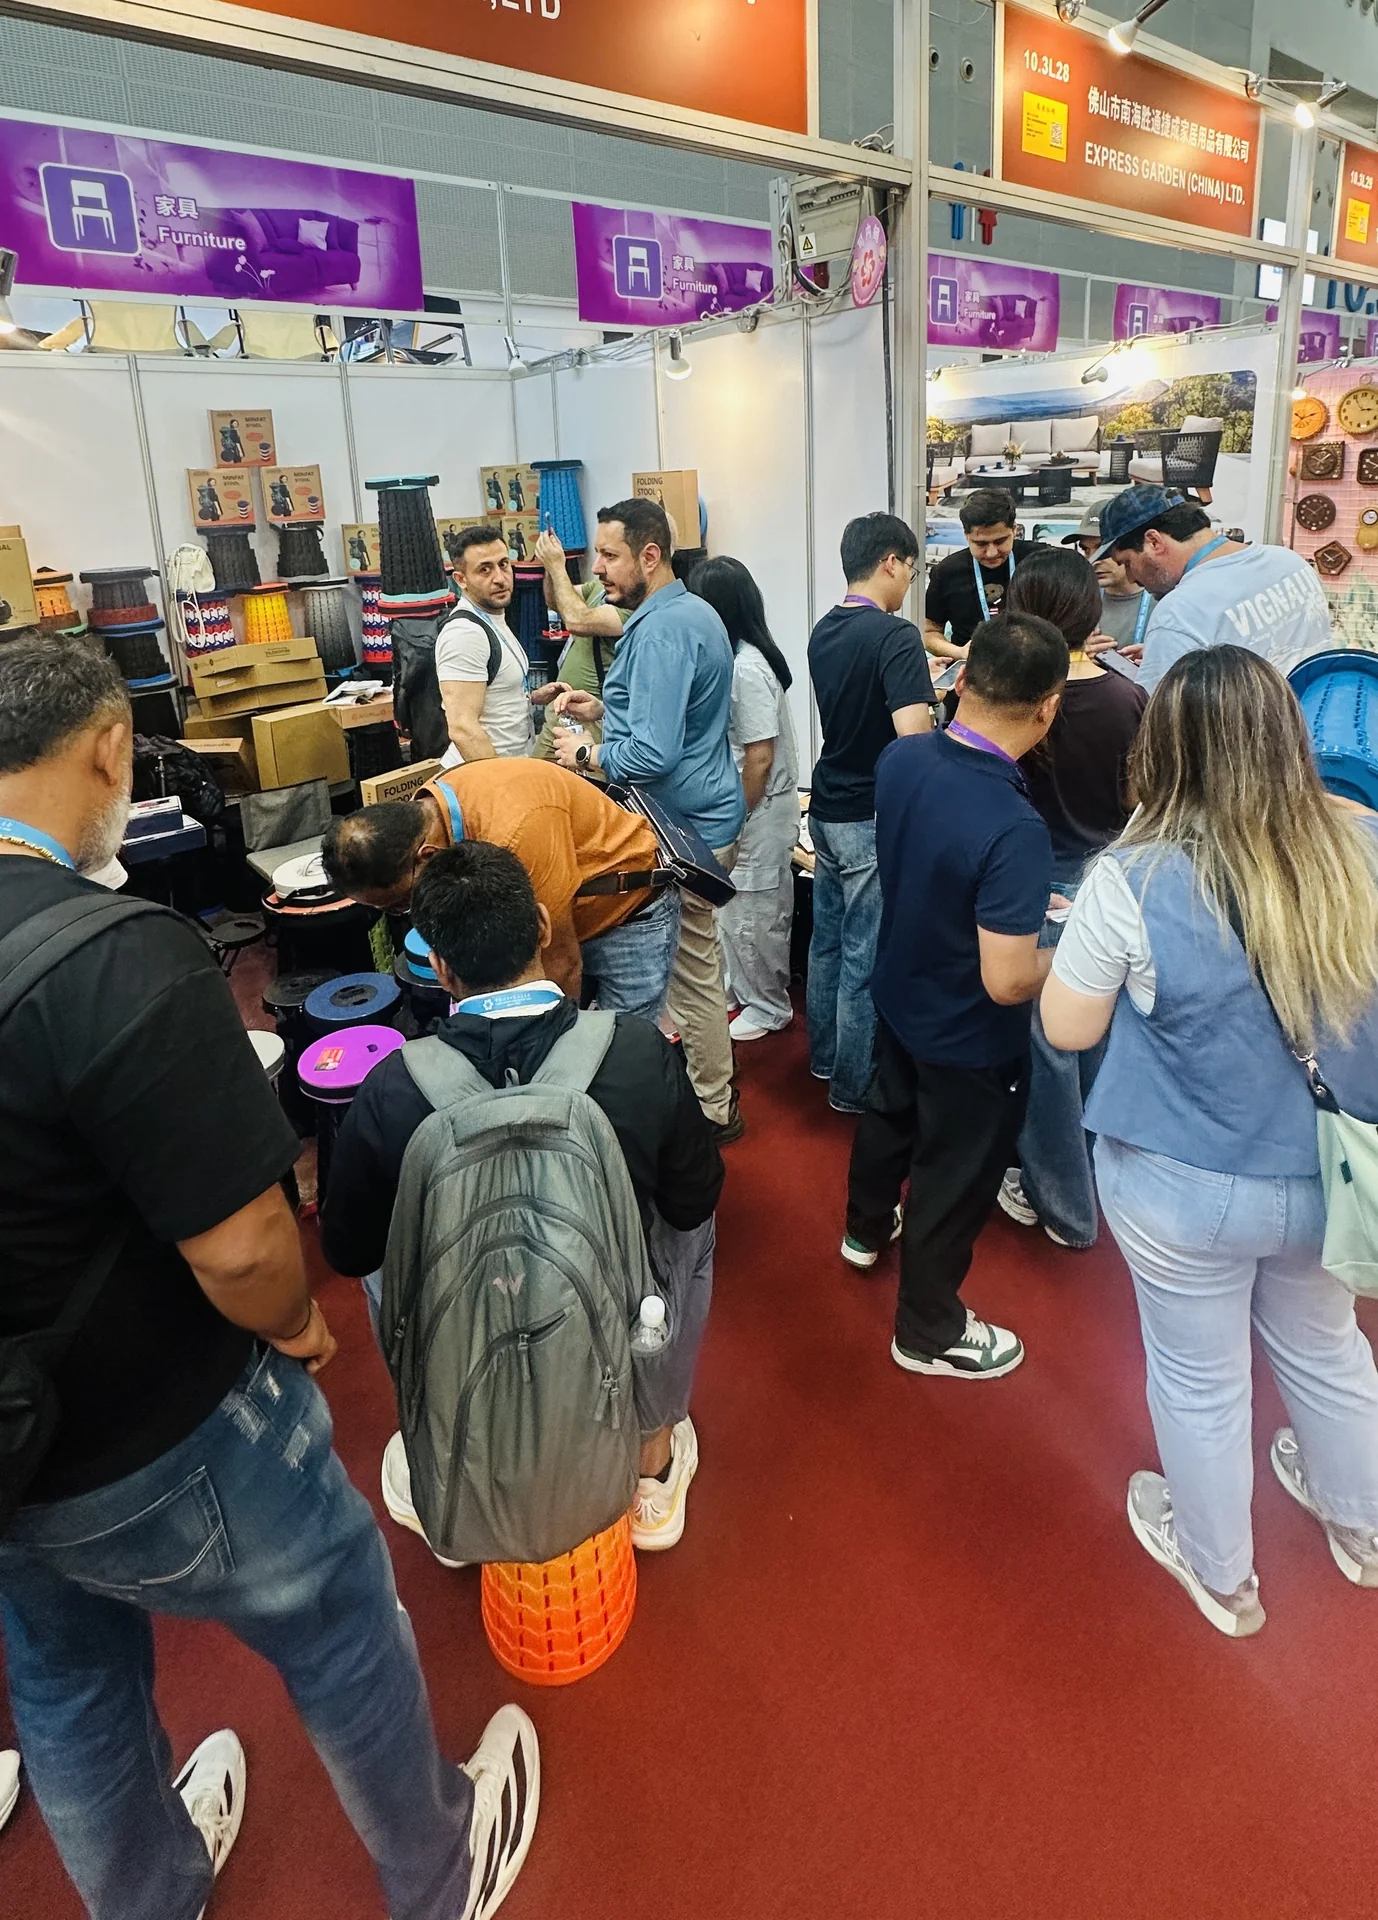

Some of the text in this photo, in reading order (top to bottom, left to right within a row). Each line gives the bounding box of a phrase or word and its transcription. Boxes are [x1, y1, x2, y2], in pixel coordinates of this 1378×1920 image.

[1023, 49, 1070, 83] 10.3L28
[1084, 141, 1246, 206] EXPRESS GARDEN (CHINA) LTD.
[154, 195, 199, 219] 家具
[157, 225, 247, 251] Furniture
[672, 254, 695, 273] 家具
[672, 277, 719, 295] Furniture
[964, 308, 997, 321] Furniture
[637, 476, 663, 486] FOLDING
[637, 488, 656, 496] STOOL
[383, 776, 424, 798] FOLDING
